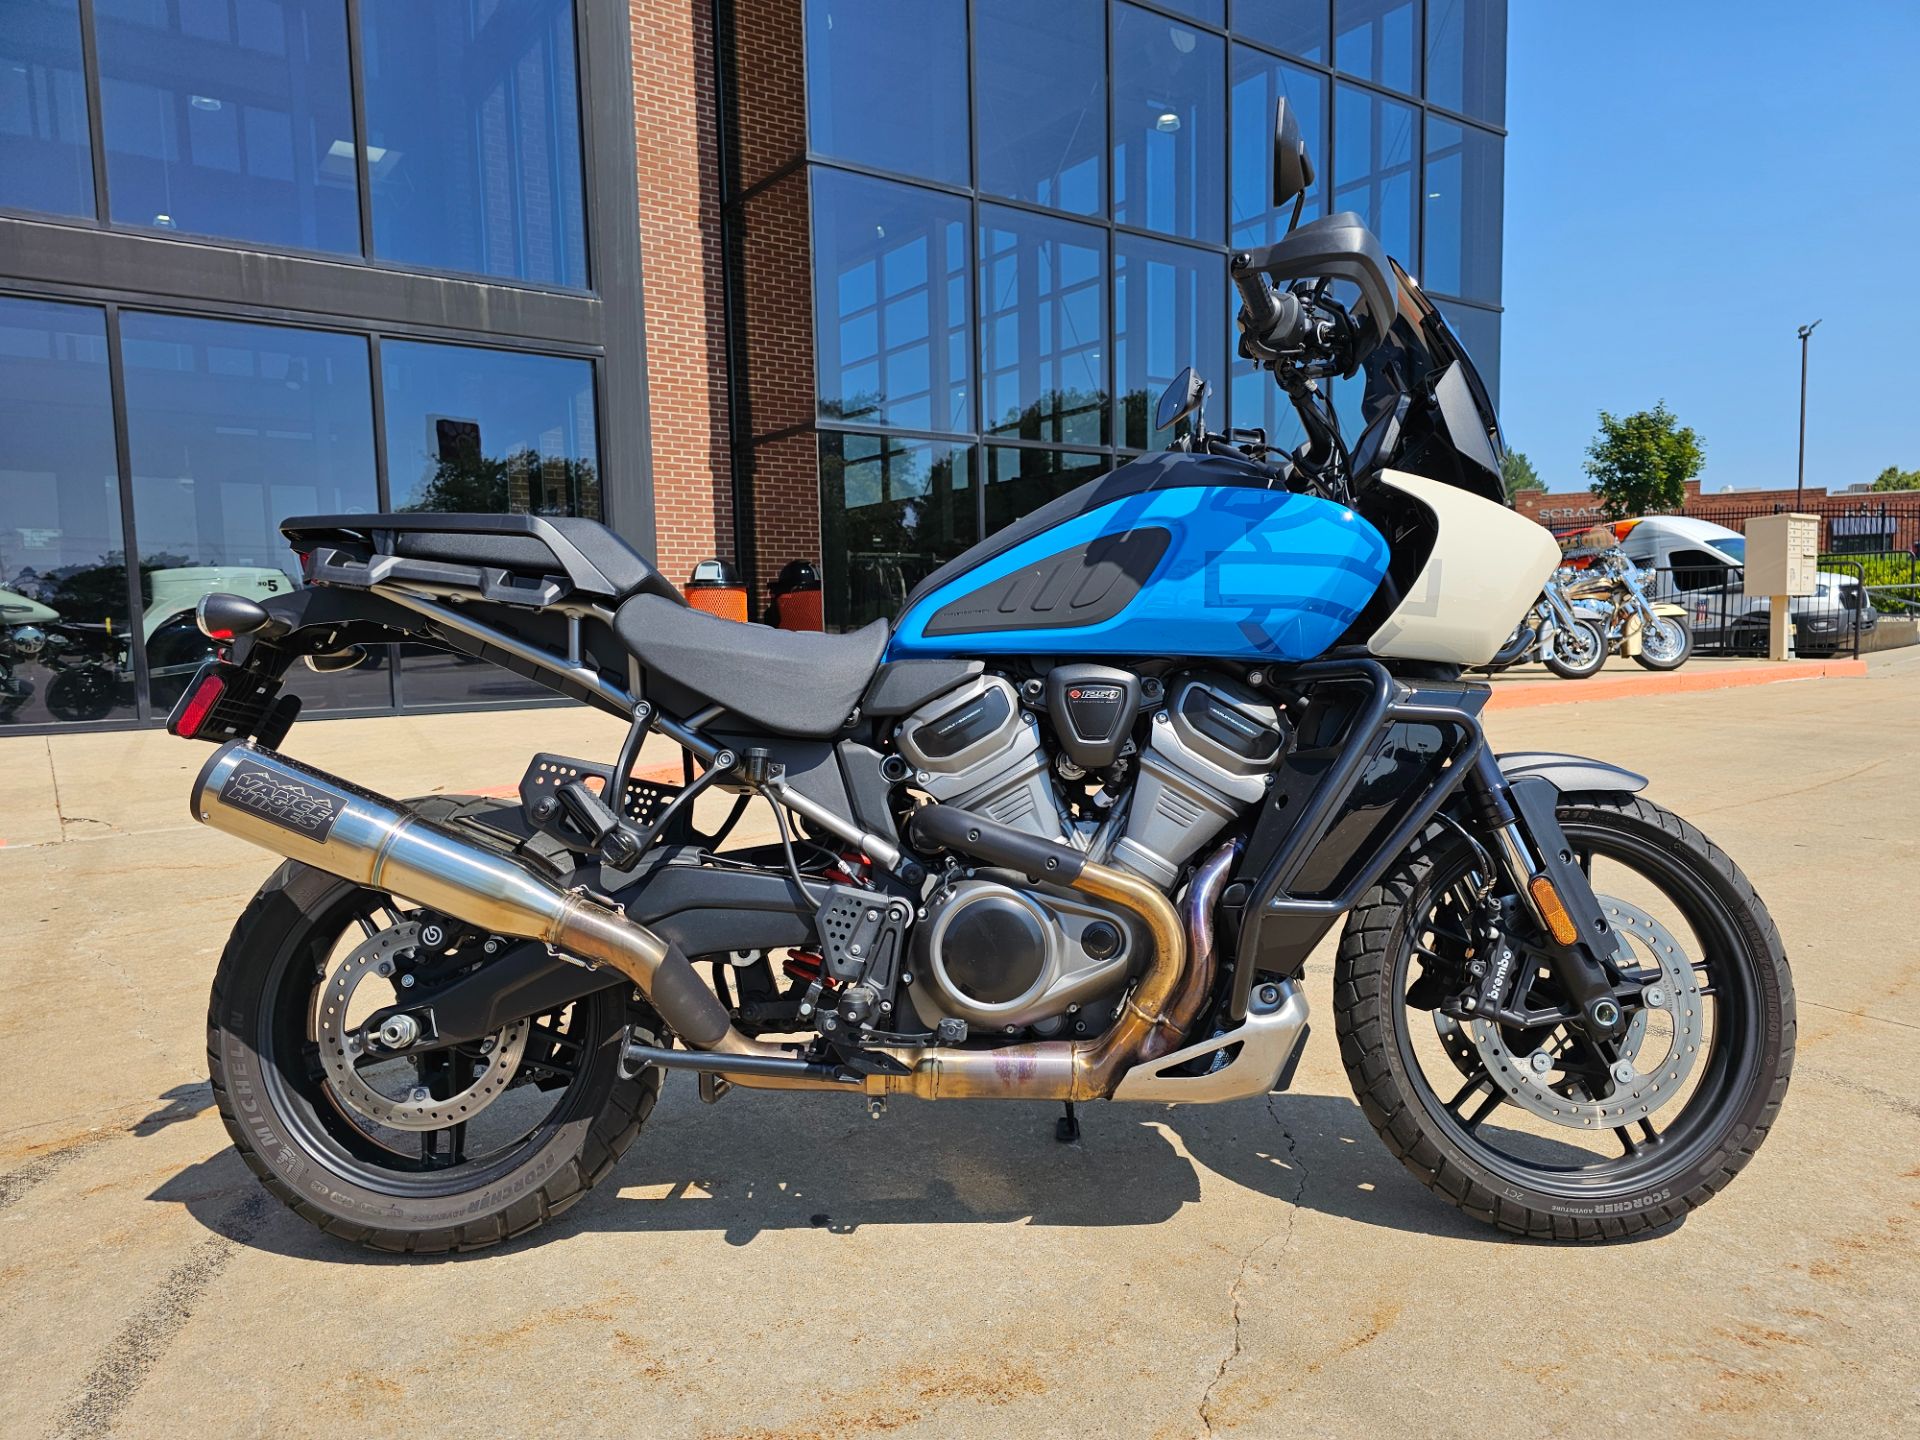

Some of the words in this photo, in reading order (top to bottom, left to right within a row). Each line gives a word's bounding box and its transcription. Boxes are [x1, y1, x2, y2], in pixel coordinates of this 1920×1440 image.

[227, 785, 322, 830] HINES
[235, 773, 333, 823] VANCE
[1487, 950, 1512, 1000] brembo
[1380, 962, 1402, 1073] MICHELIN
[229, 1010, 278, 1147] MICHELIN
[1502, 1187, 1525, 1201] 2CT
[1551, 1204, 1593, 1214] ADVENTURE
[1595, 1187, 1672, 1214] SCORCHER
